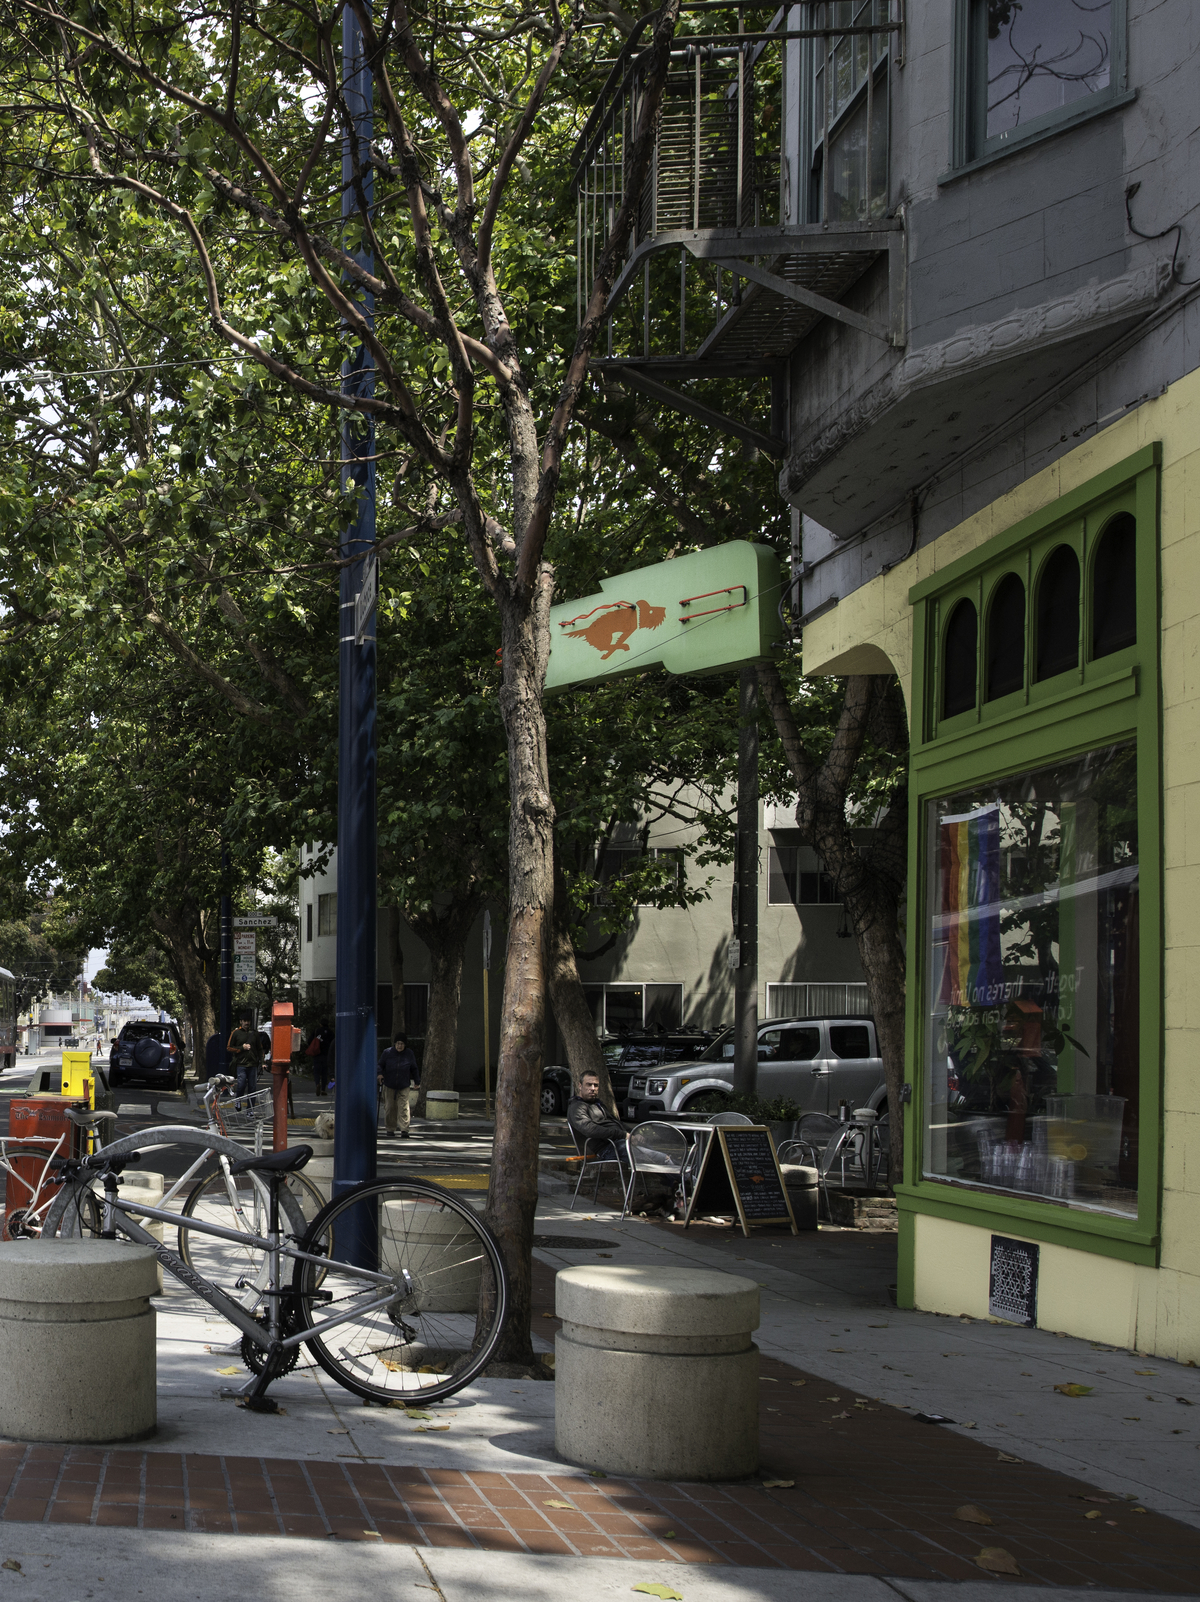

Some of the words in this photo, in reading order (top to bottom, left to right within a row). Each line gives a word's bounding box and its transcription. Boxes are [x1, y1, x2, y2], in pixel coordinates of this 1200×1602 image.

[238, 918, 272, 926] Sanchez
[15, 1111, 29, 1121] The
[145, 1241, 214, 1299] Novara
